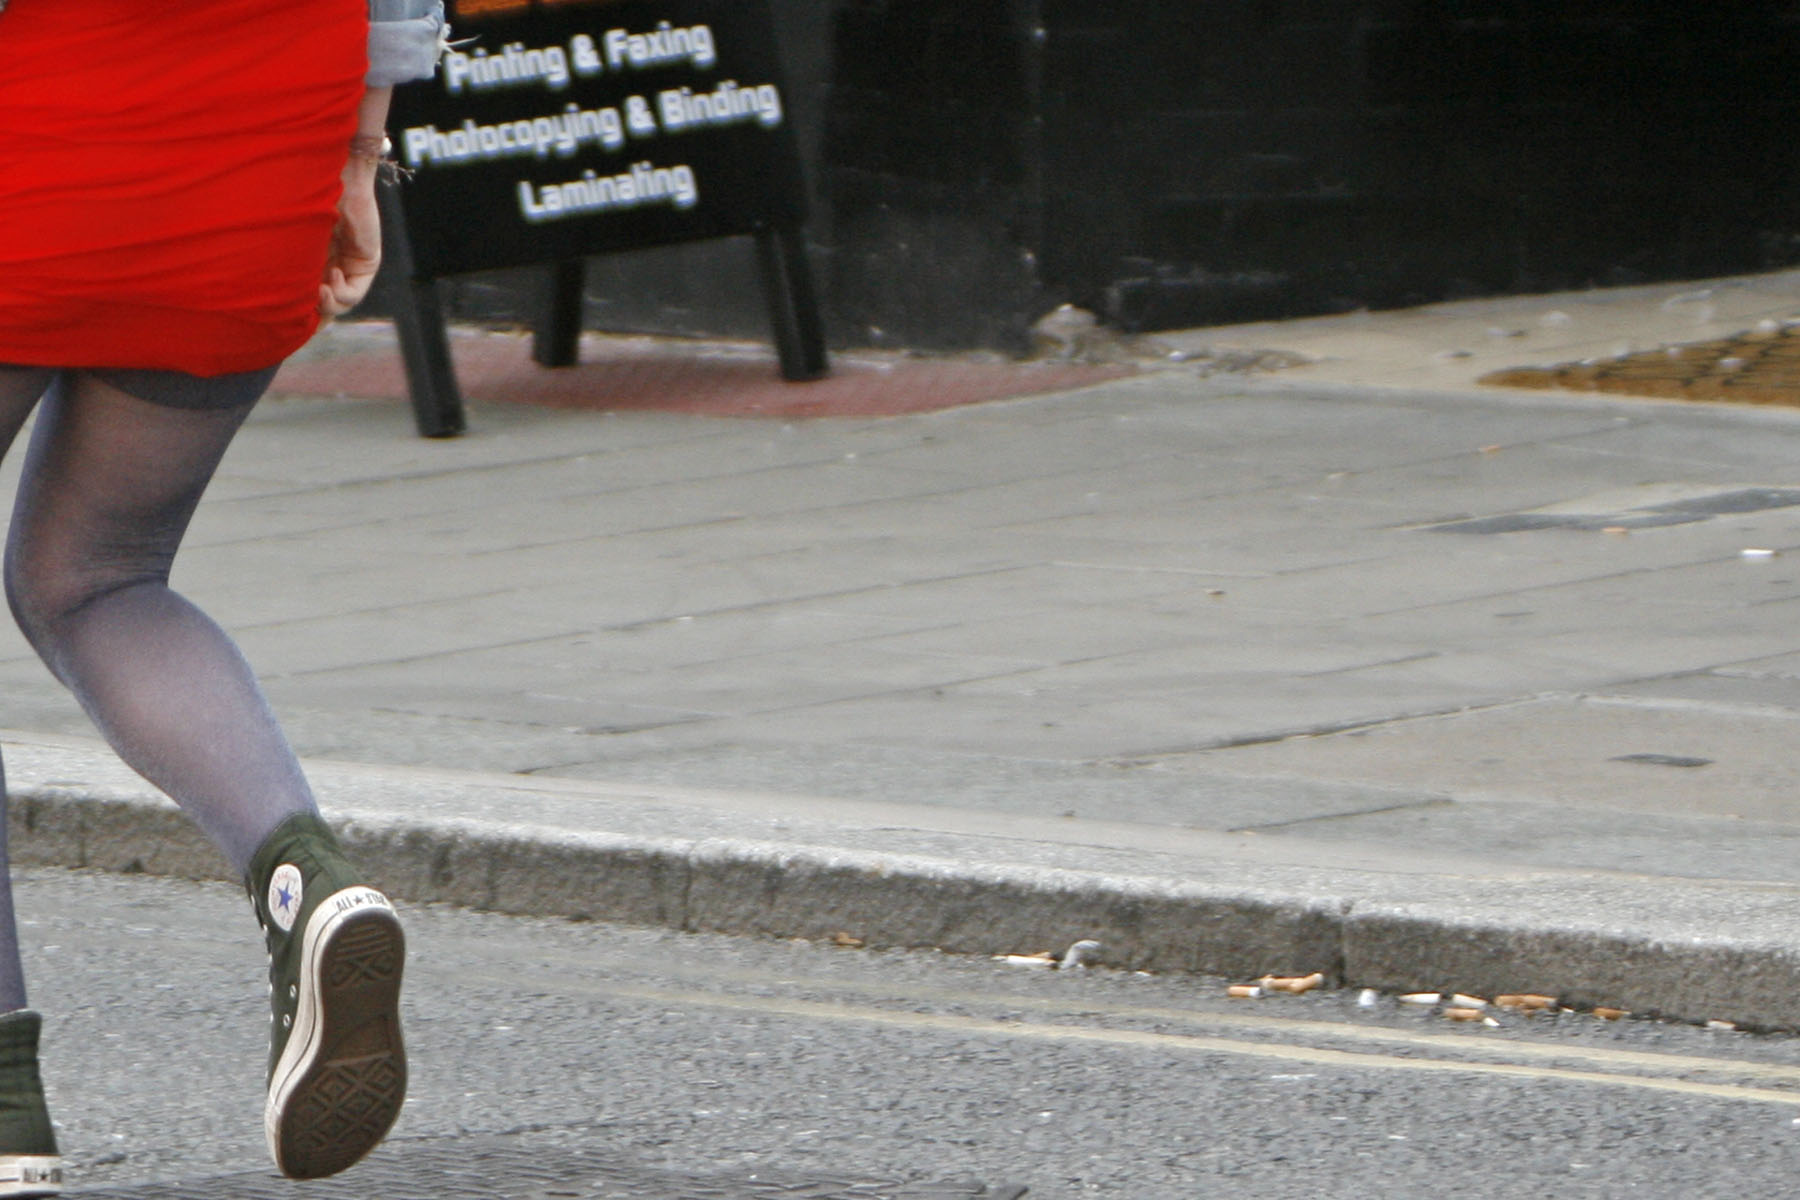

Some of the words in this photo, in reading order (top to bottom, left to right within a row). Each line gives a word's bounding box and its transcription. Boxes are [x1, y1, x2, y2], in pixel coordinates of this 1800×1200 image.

[444, 41, 570, 90] Printing
[570, 33, 601, 76] &
[604, 20, 717, 68] Faxing
[404, 102, 625, 167] Photocopying
[624, 94, 656, 136] &
[658, 79, 784, 127] Binding
[517, 160, 698, 221] Laminating
